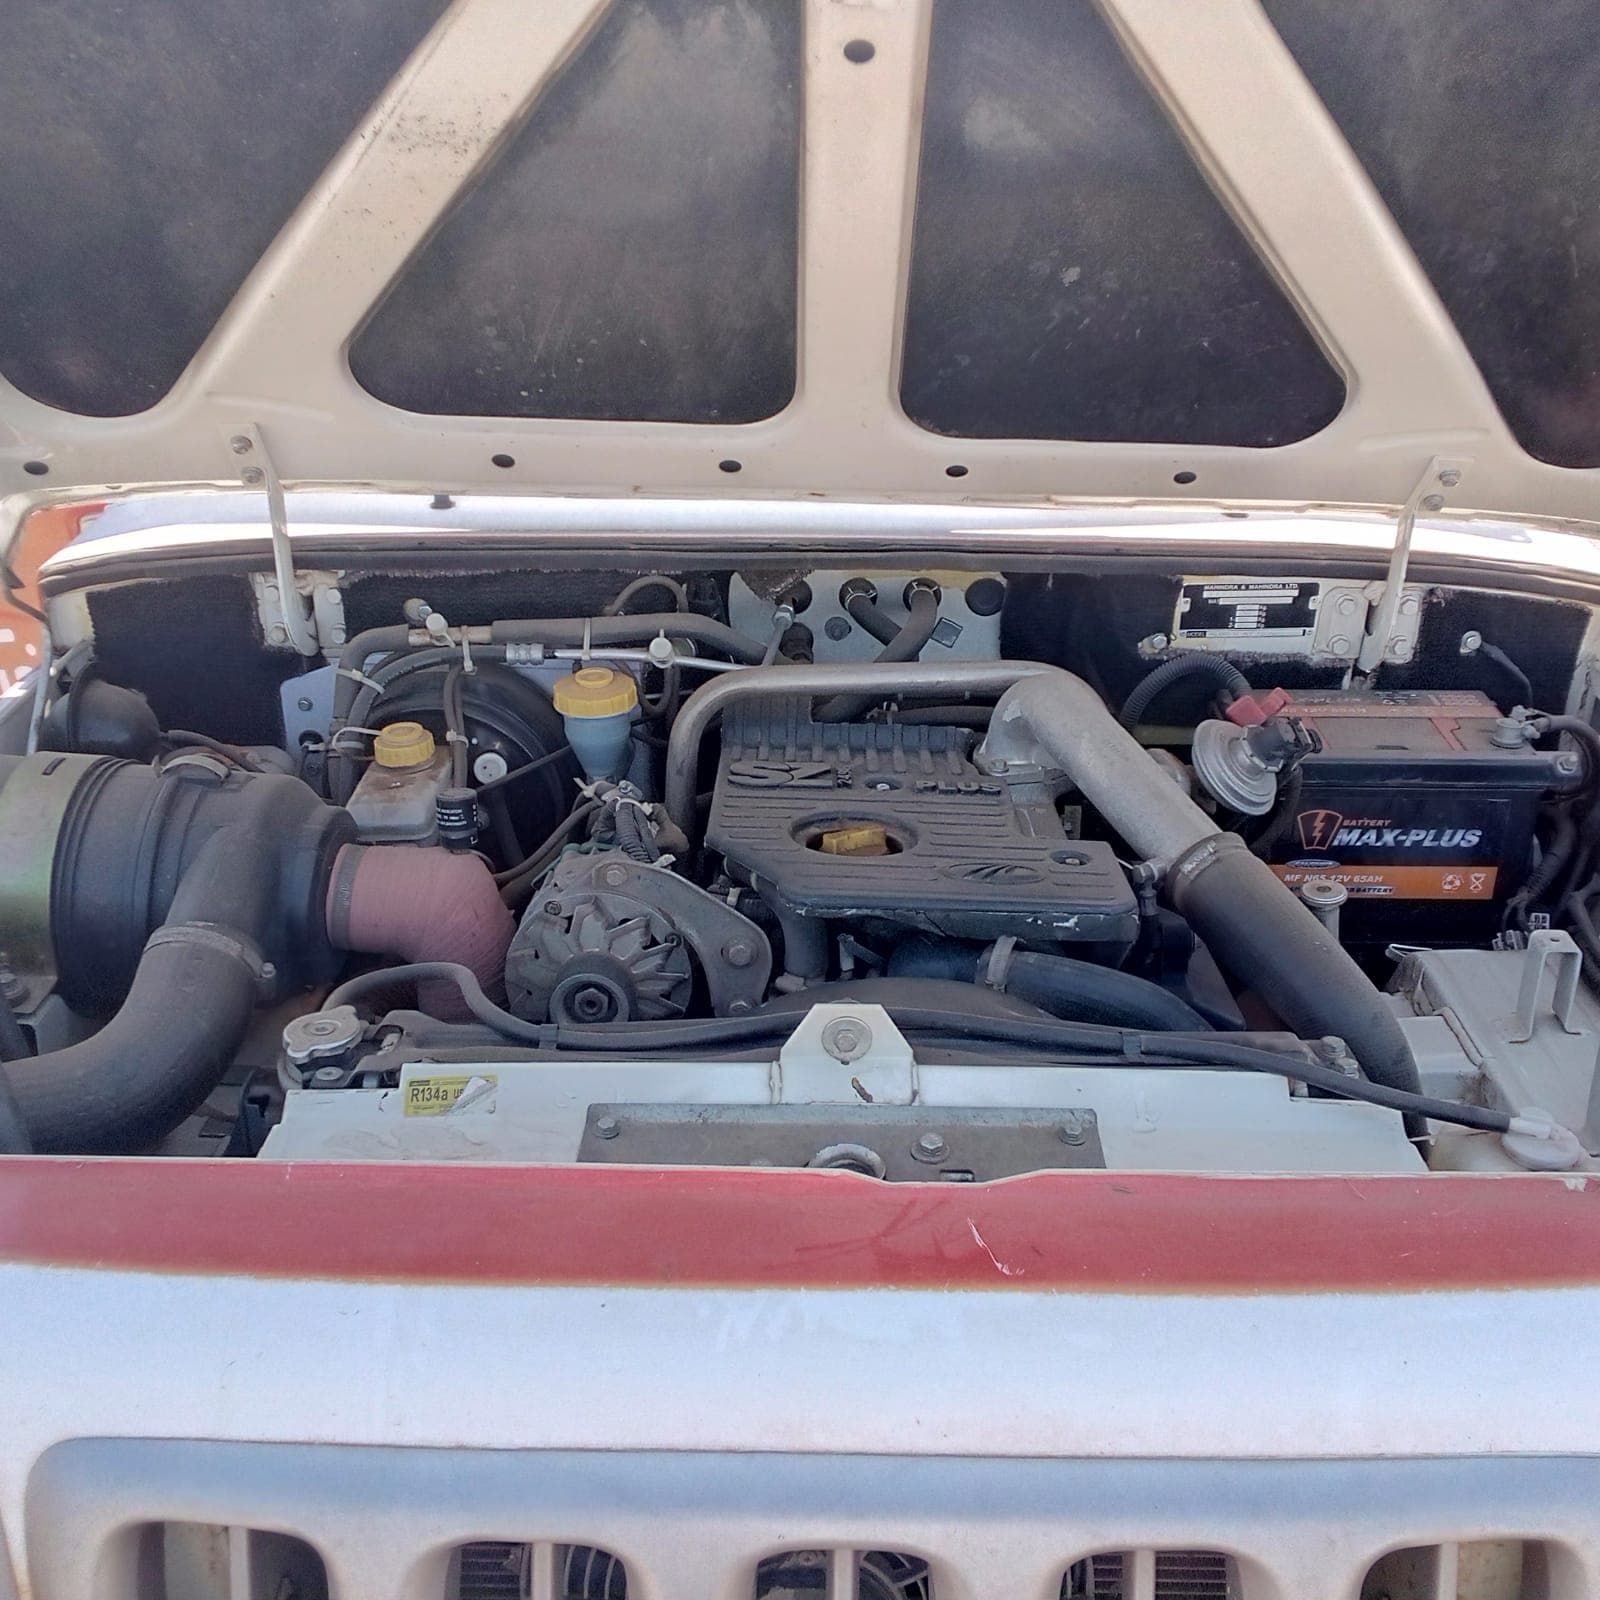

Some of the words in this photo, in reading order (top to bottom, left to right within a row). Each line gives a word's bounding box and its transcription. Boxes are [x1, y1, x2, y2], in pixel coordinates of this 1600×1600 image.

[915, 780, 1001, 795] PLUS
[1332, 828, 1482, 847] MAX-PLUS
[1284, 874, 1301, 882] MF
[1353, 875, 1384, 883] 65AH
[1355, 886, 1394, 894] BATTERY
[410, 1087, 448, 1102] R134a
